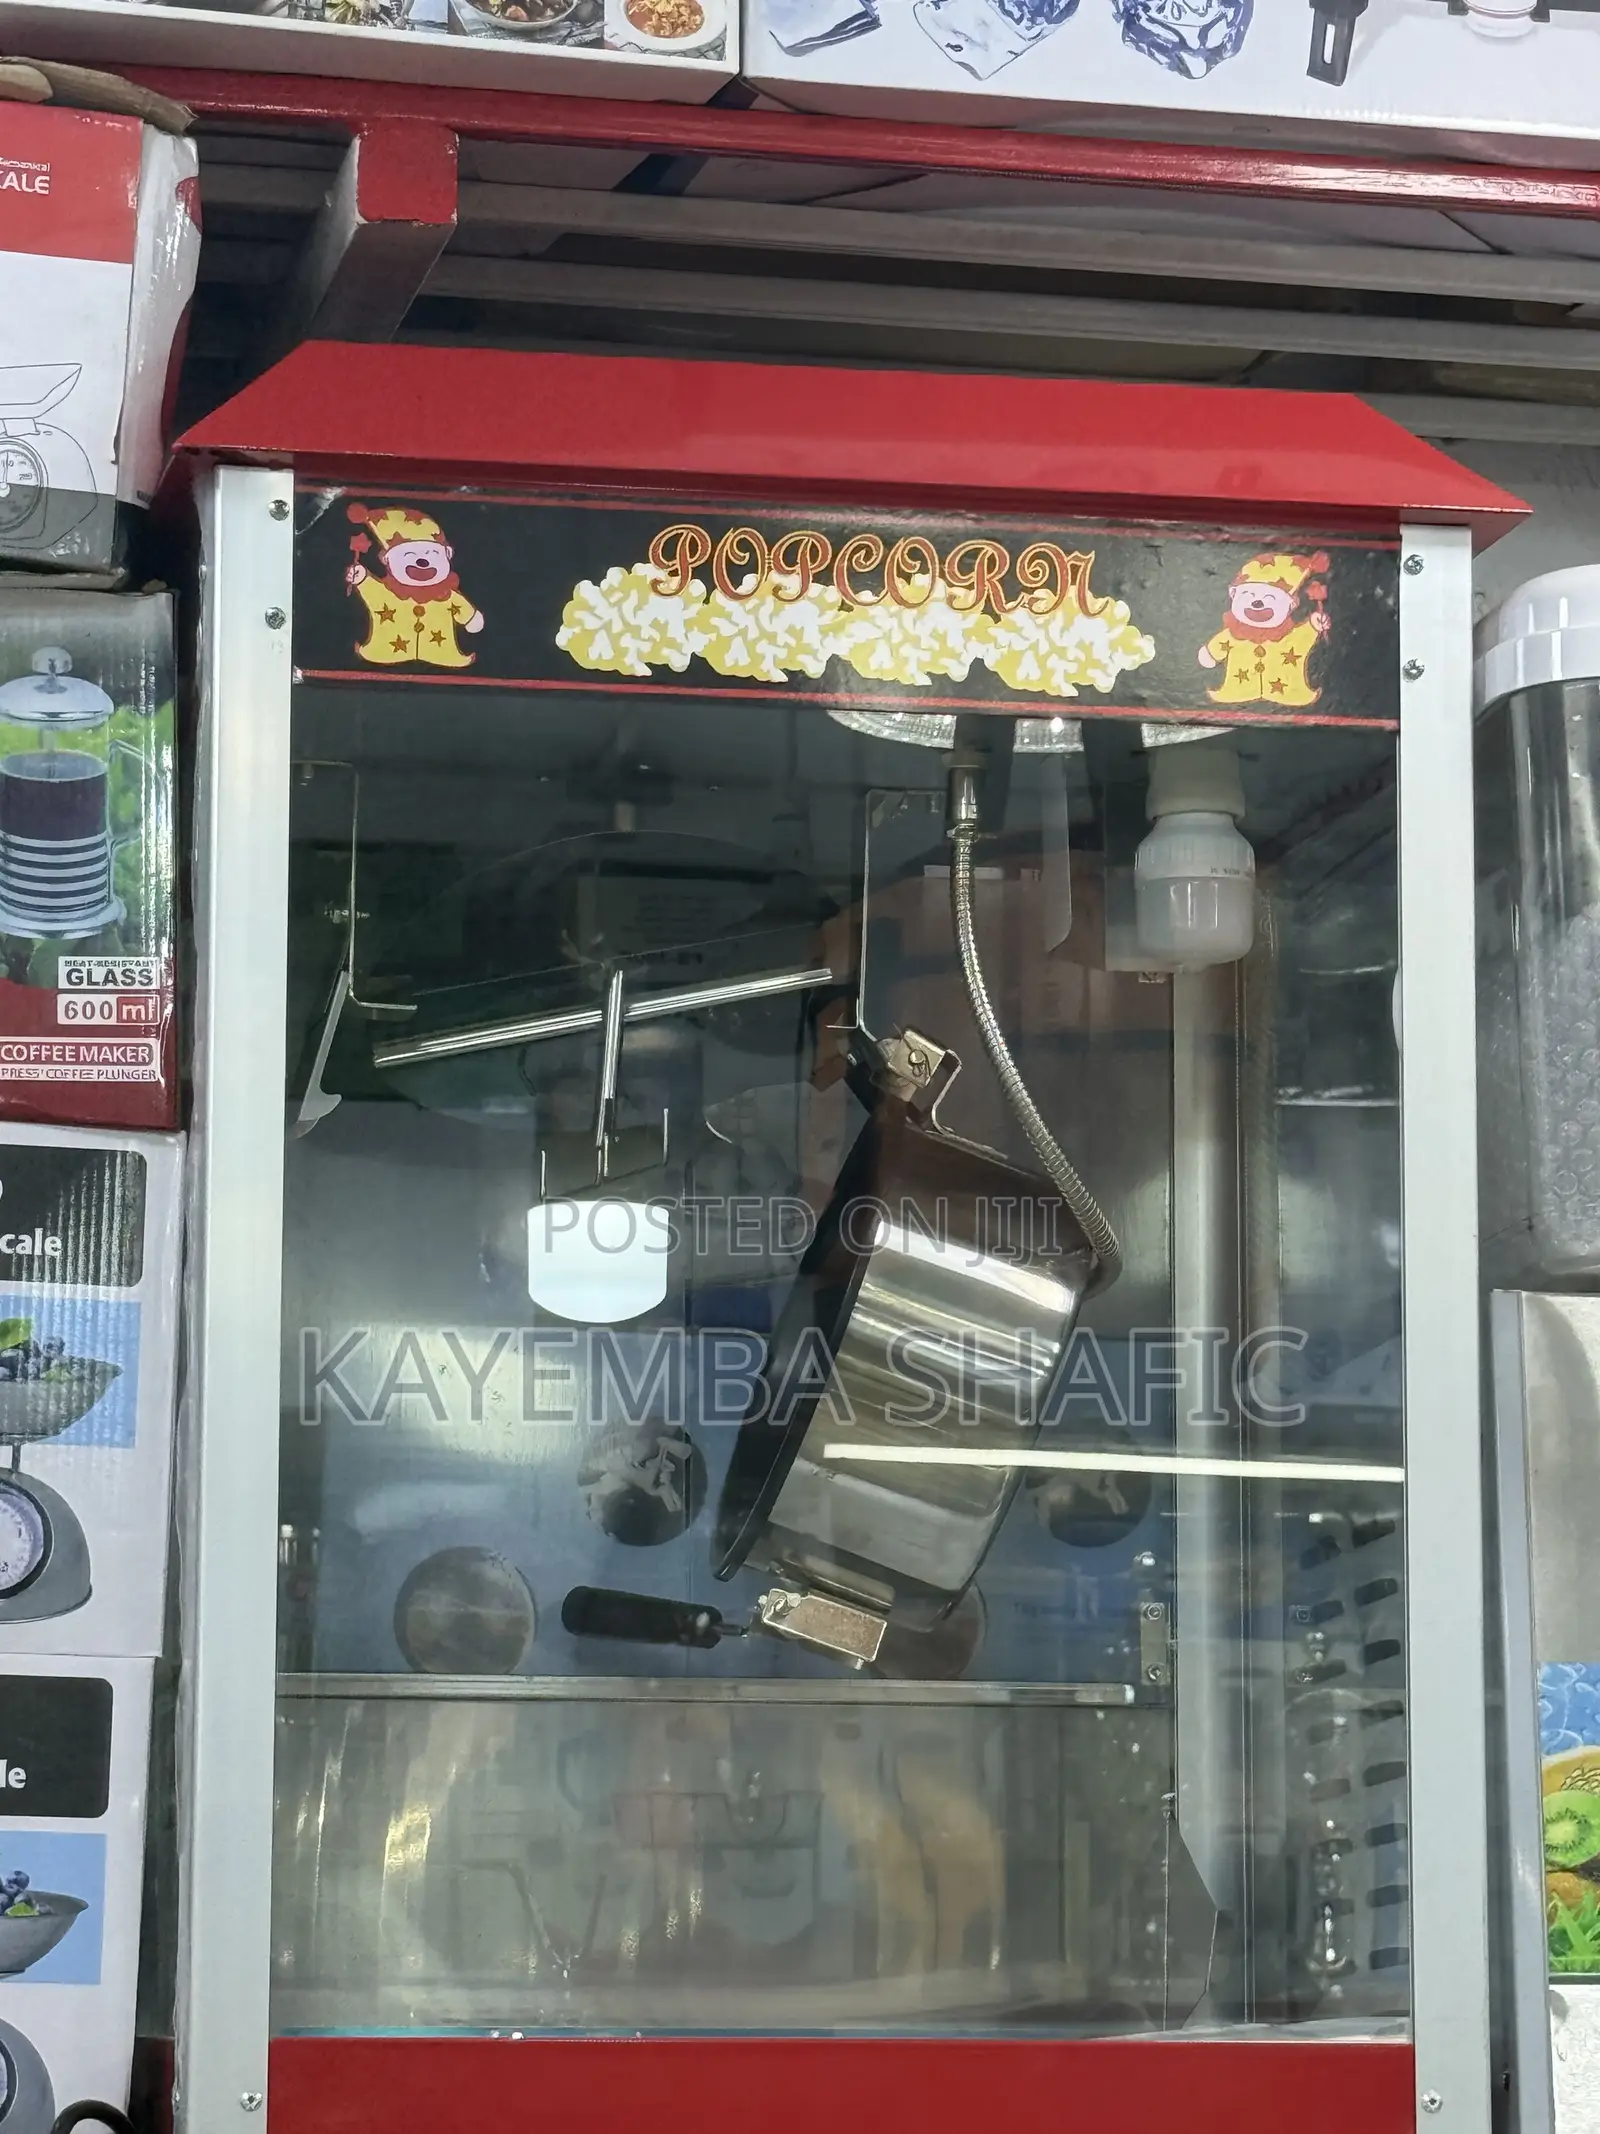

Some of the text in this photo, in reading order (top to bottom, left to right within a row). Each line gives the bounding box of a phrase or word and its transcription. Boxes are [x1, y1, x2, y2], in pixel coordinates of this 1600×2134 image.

[0, 171, 50, 195] ALE
[648, 523, 1108, 617] POPCORN
[66, 968, 154, 987] GLASS
[64, 1000, 113, 1020] 600
[0, 1044, 150, 1063] COFFEE MAKER
[46, 1068, 94, 1080] COFFEE
[97, 1068, 156, 1081] PLUNGER
